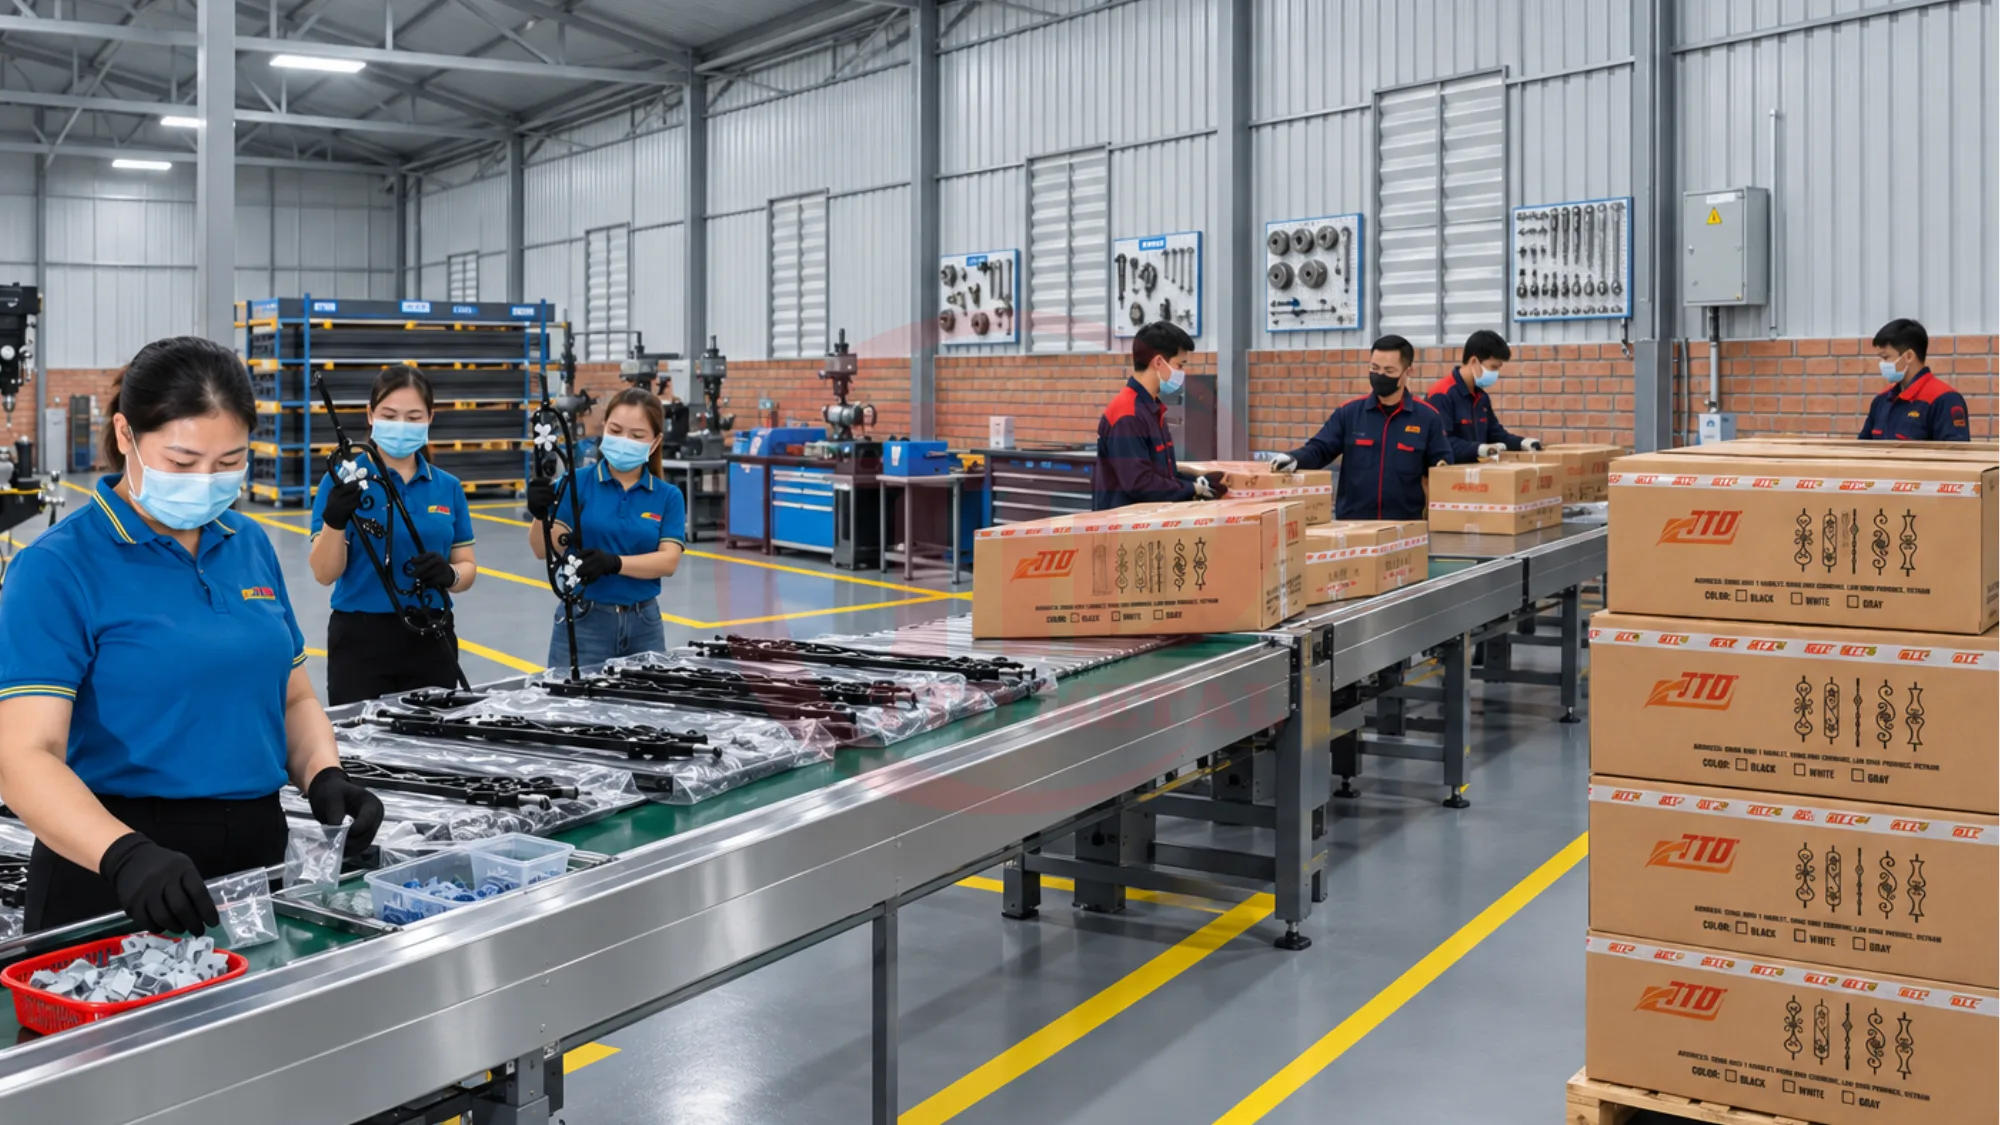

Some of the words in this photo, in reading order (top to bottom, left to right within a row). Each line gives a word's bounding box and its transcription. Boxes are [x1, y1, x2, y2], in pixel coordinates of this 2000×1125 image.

[1750, 593, 1774, 603] BLACK
[1750, 762, 1776, 774] BLACK
[1867, 773, 1890, 784] GRAY
[1702, 920, 1732, 932] COLOR:
[1750, 926, 1777, 939] BLACK
[1809, 934, 1836, 947] WHITE
[1691, 1066, 1721, 1079] COLOR:
[1740, 1075, 1766, 1088] BLACK
[1798, 1086, 1825, 1099] WHITE
